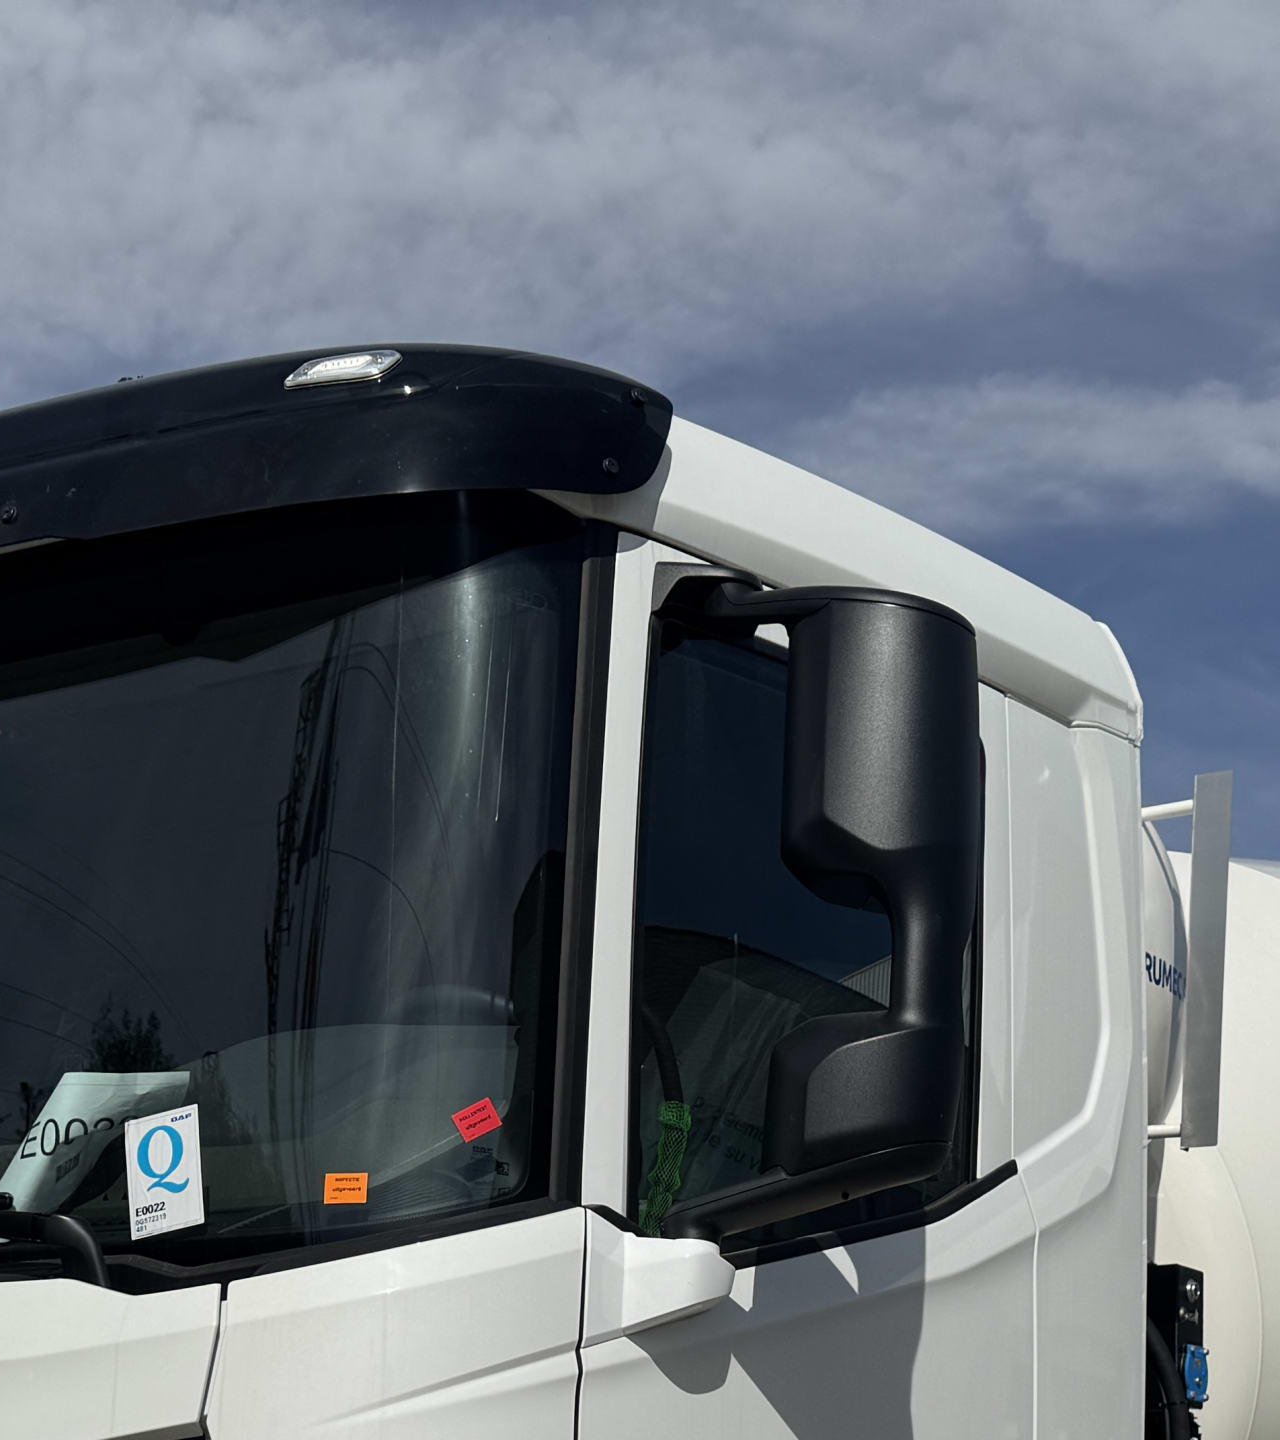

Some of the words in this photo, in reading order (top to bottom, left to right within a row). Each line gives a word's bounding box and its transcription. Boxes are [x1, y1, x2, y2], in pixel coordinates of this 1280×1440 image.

[1145, 951, 1187, 1001] RUMEC
[170, 1112, 192, 1123] DAF
[137, 1125, 190, 1194] Q
[135, 1201, 166, 1217] E0022
